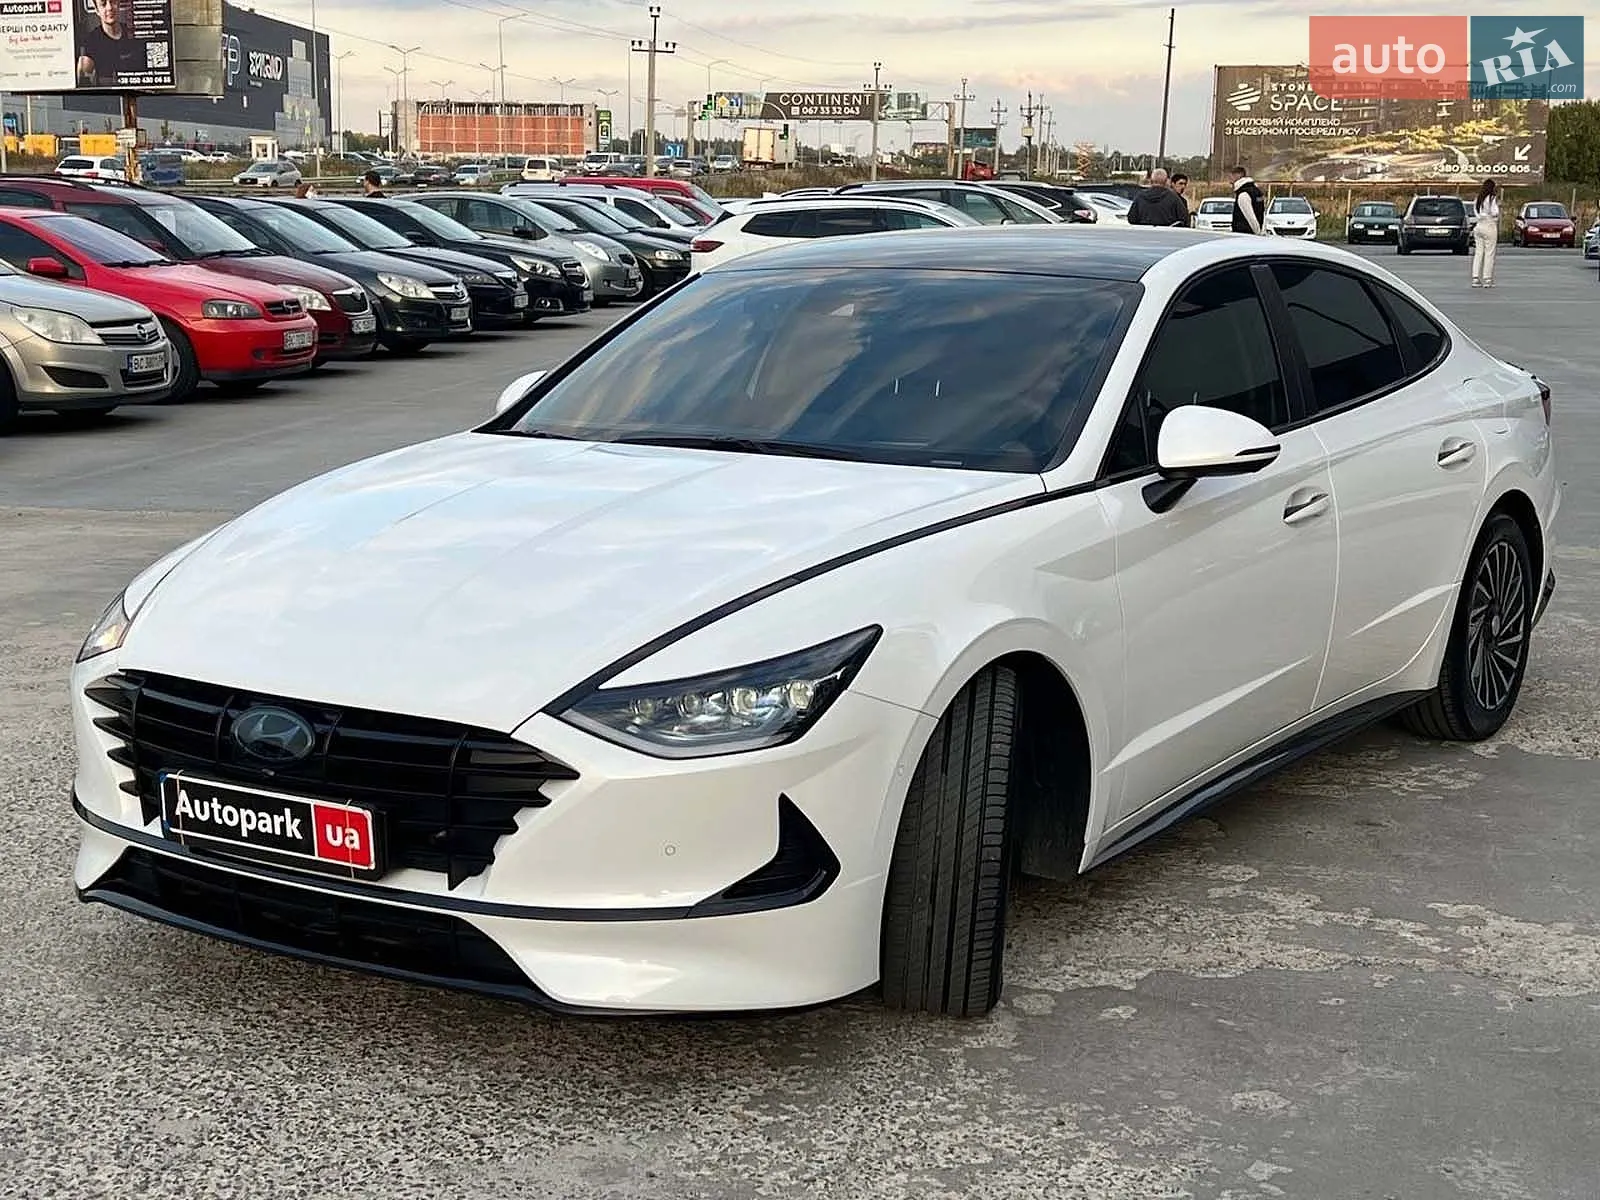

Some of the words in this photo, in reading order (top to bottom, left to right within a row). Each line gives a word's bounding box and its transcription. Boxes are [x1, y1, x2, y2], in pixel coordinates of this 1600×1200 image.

[0, 24, 23, 33] ЕРШІ
[25, 24, 38, 32] ПО
[40, 23, 69, 32] ФАКТУ
[780, 93, 872, 105] CONTINENT
[1270, 94, 1343, 111] SPACE
[801, 106, 818, 115] 067
[1233, 126, 1288, 136] БАСЕЙНОМ
[1289, 127, 1337, 136] ПОСЕРЕД
[175, 789, 303, 839] Autopark
[325, 822, 360, 850] ua
